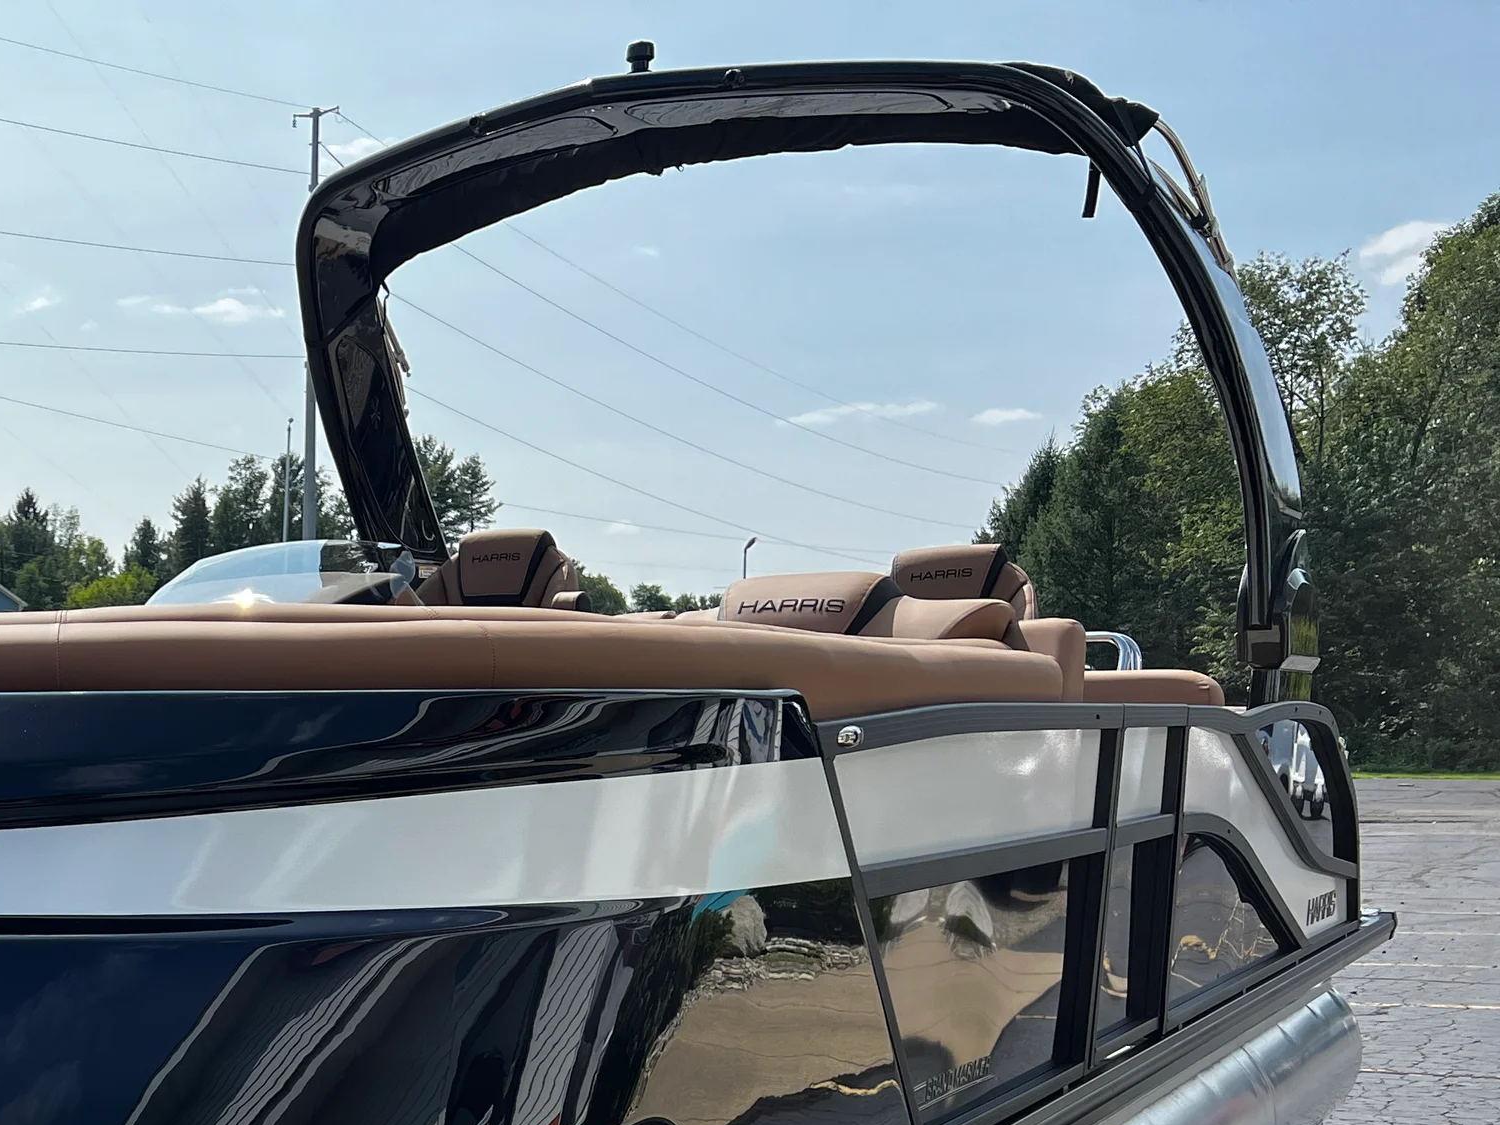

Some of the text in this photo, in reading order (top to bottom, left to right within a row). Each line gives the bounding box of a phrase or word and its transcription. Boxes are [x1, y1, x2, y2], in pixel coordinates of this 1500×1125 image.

[471, 552, 521, 564] HARRIS
[911, 567, 973, 582] HARRIS
[737, 598, 846, 615] HARRIS
[1306, 889, 1337, 927] HARRIS
